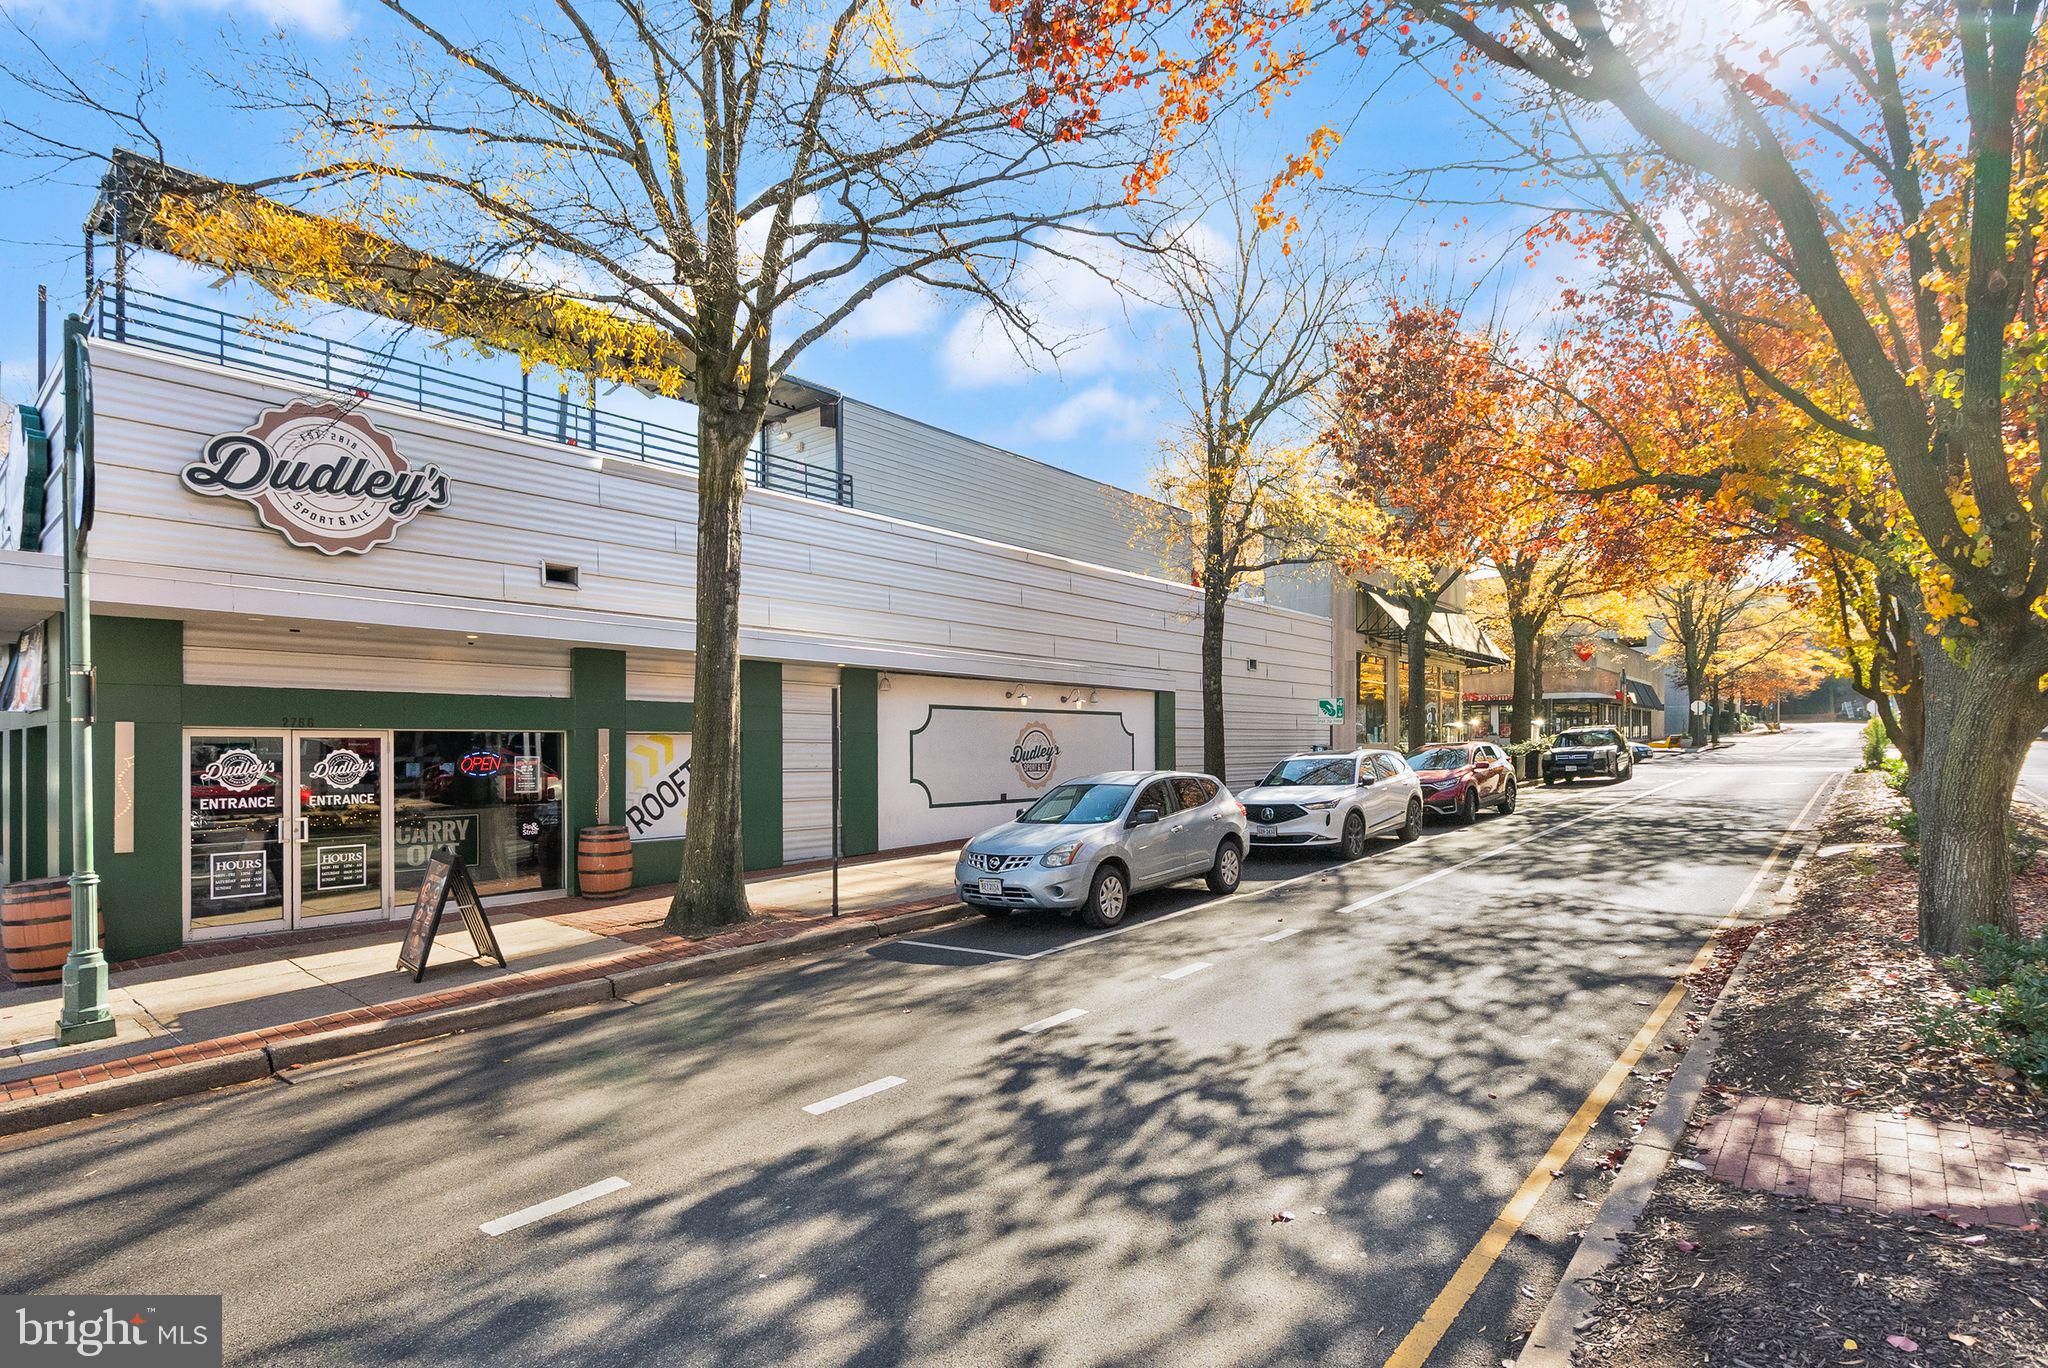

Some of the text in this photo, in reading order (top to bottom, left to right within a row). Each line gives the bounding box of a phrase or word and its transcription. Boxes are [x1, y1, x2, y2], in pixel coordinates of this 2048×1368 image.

[185, 435, 449, 516] Dudley's
[292, 501, 371, 526] SPORT & ALE
[1010, 744, 1061, 763] Dudley's
[200, 760, 275, 780] Dudley's
[309, 759, 375, 779] Dudley's
[460, 756, 502, 771] OPEN
[200, 796, 275, 810] ENTRANCE
[309, 793, 375, 806] ENTRANCE
[395, 819, 469, 845] CARRY
[216, 859, 262, 871] HOURS
[322, 852, 362, 865] HOURS
